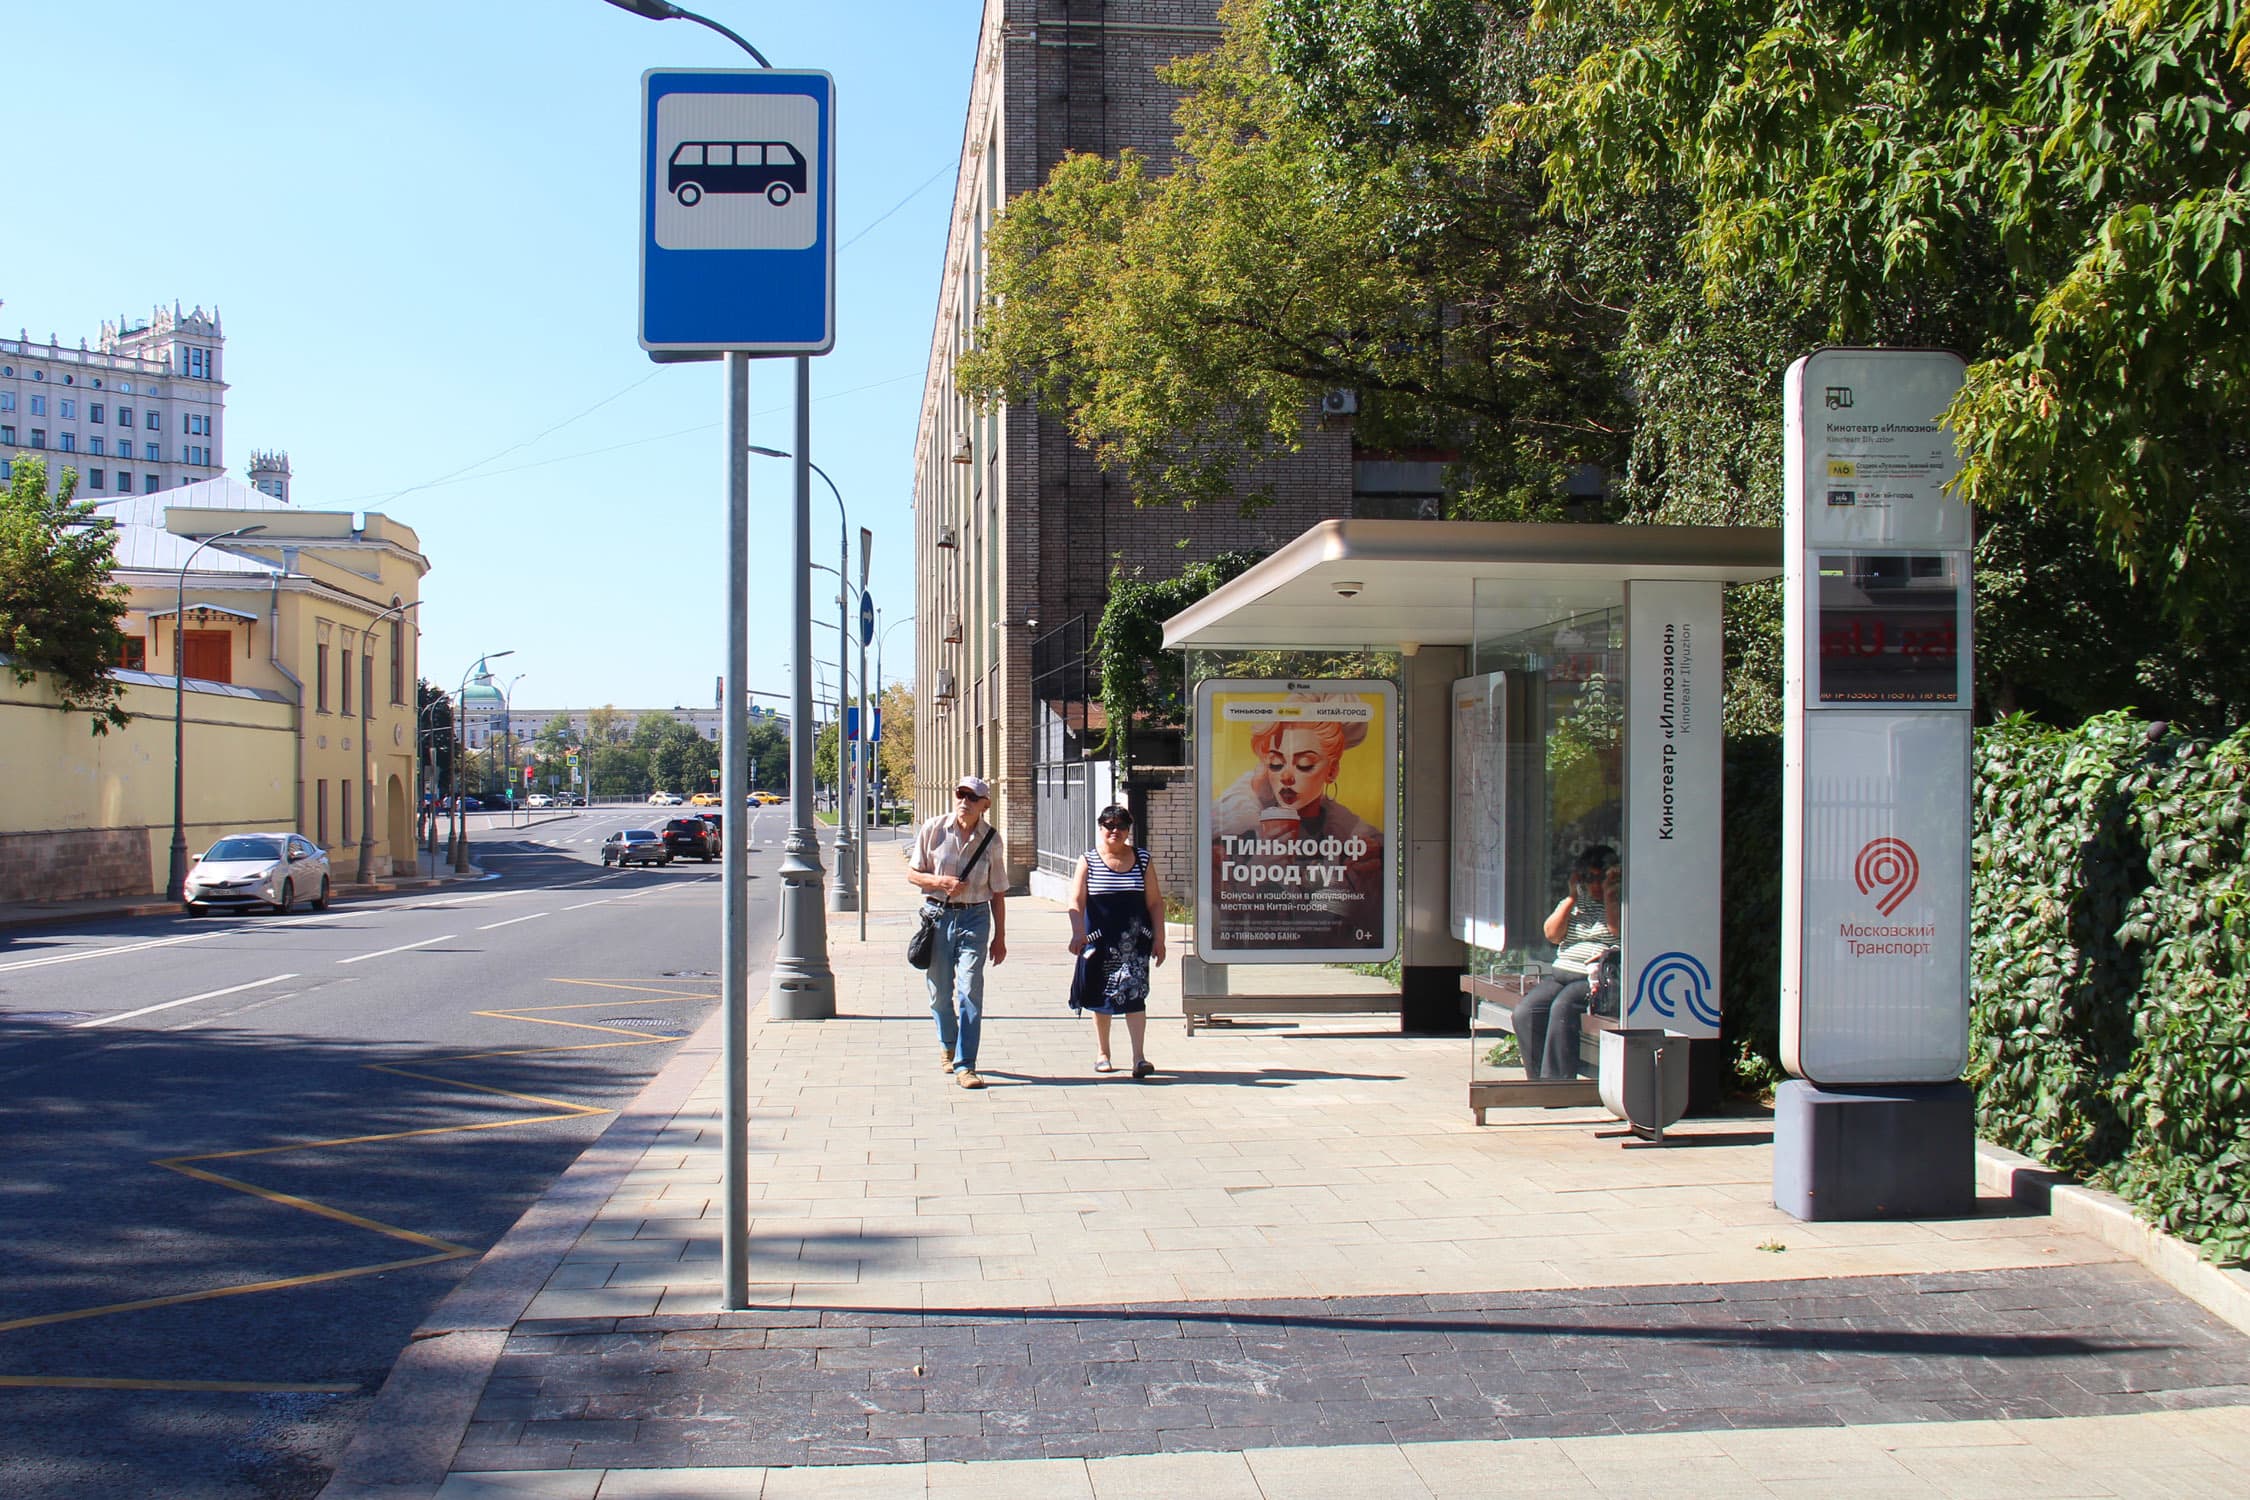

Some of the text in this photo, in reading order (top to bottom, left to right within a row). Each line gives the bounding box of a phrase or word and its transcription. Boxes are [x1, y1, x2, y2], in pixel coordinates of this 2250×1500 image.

[1826, 423, 1940, 434] Кинотеатр «Иллюзион
[1870, 491, 1914, 500] Киай-город
[1680, 623, 1692, 734] Kinoteatr Illyuzion
[1316, 707, 1367, 716] КИТАЙ-ГОРОД
[1659, 623, 1678, 840] Кинотеатр «Иллюзион»
[1221, 835, 1367, 861] Тинькофф
[1221, 861, 1347, 887] Город тут
[1220, 890, 1365, 903] Бонусы и кэшбэки в популярных
[1220, 902, 1328, 912] местах на Китай-городе
[1355, 929, 1373, 941] 0+
[1839, 922, 1935, 937] Московский
[1220, 932, 1301, 941] АО «ТИНЬКОФФ БАНК»
[1847, 940, 1931, 958] Транспорт
